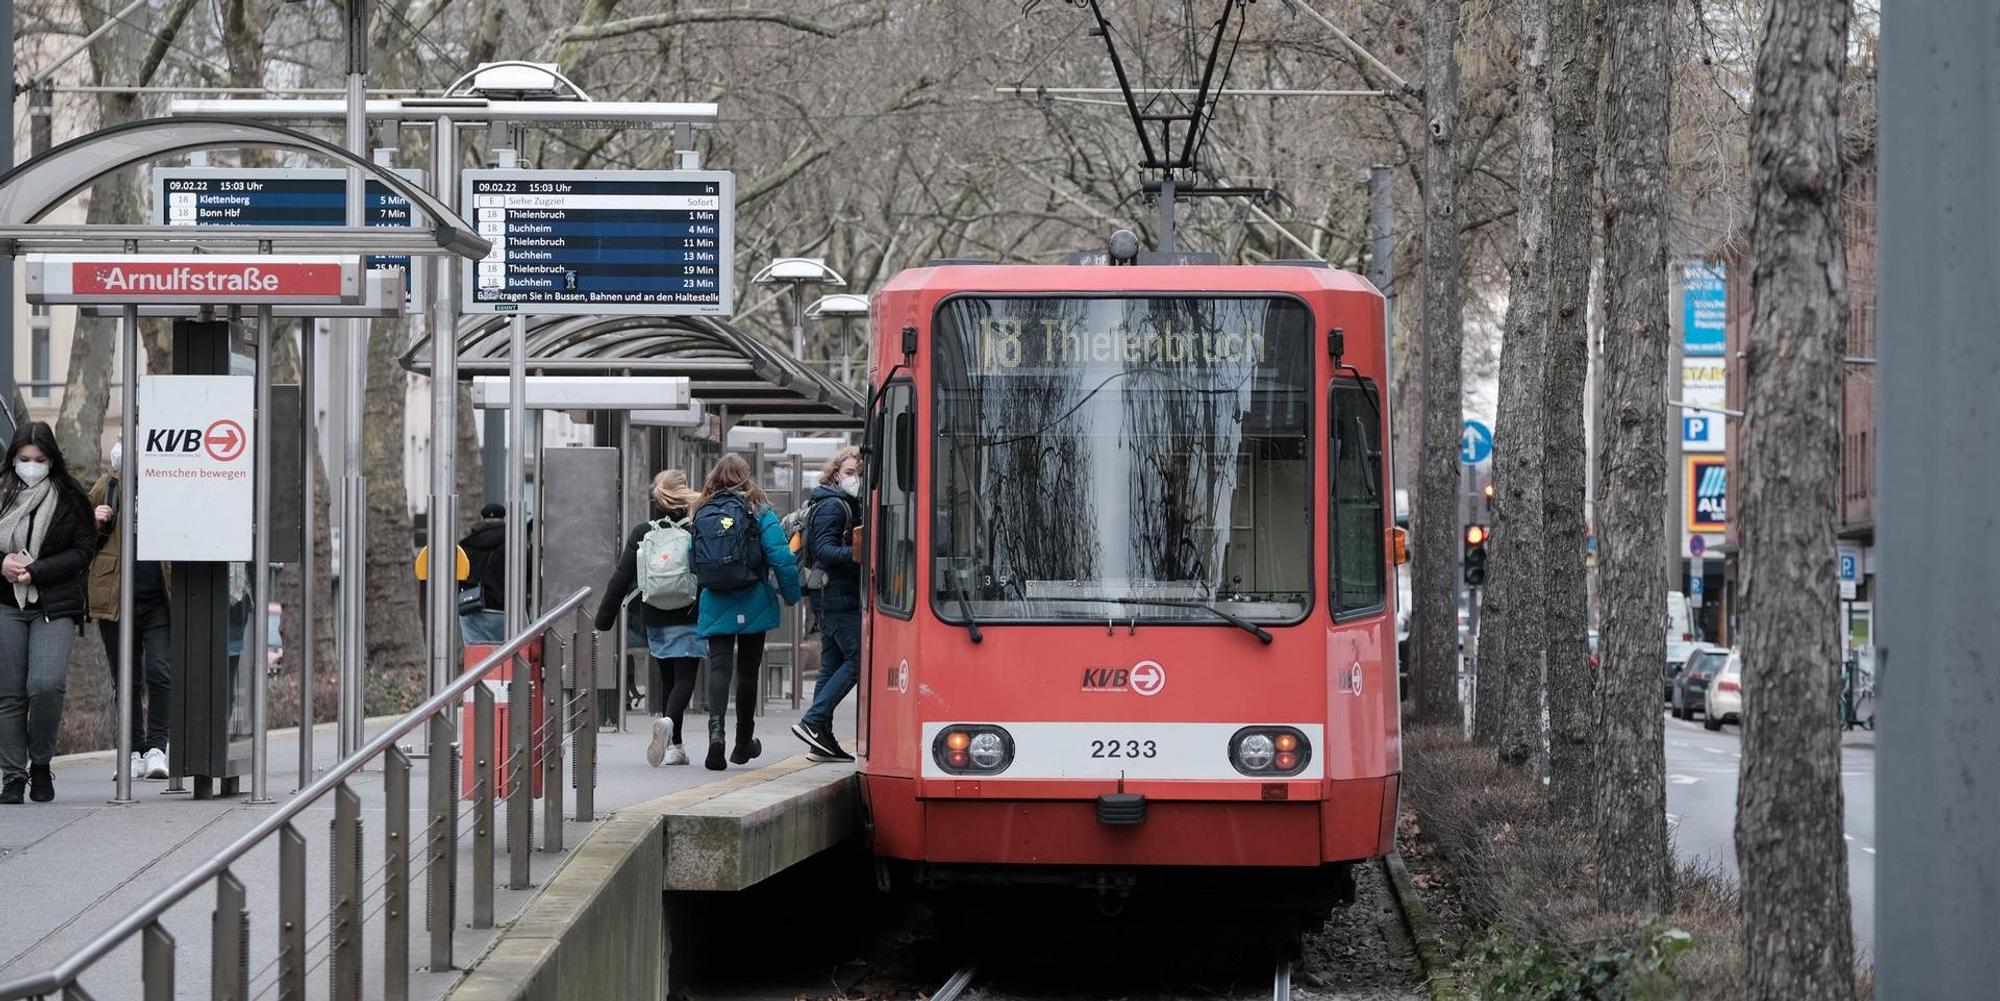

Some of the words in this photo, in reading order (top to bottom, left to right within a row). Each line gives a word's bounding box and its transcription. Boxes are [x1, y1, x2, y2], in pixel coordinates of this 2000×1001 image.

[169, 181, 208, 190] 09.02.22
[220, 181, 244, 191] 15:03
[246, 181, 264, 191] Uhr
[478, 183, 517, 192] 09.02.22
[529, 183, 553, 192] 15:03
[555, 183, 572, 192] Uhr
[705, 184, 714, 193] in
[200, 195, 250, 206] Klettenberg
[380, 196, 386, 205] 5
[388, 196, 406, 205] Min
[508, 197, 532, 206] Siehe
[534, 197, 565, 208] Zugziel
[687, 198, 714, 207] Sofort
[178, 209, 189, 217] 18
[200, 208, 223, 217] Bonn
[224, 208, 241, 217] Hbf
[380, 209, 386, 218] 7
[388, 209, 406, 218] Min
[487, 210, 497, 219] 18
[508, 210, 565, 219] Thielenbruch
[689, 211, 694, 220] 1
[696, 211, 714, 220] Min
[487, 224, 497, 233] 18
[508, 224, 552, 233] Buchheim
[688, 225, 695, 234] 4
[696, 225, 714, 234] Min
[508, 237, 565, 246] Thielenbruch
[683, 238, 695, 248] 11
[696, 239, 714, 248] Min
[508, 250, 552, 260] Buchheim
[683, 252, 695, 261] 13
[696, 252, 714, 261] Min
[487, 265, 497, 273] 18
[508, 264, 565, 274] Thielenbruch
[683, 266, 695, 275] 19
[696, 266, 714, 275] Min
[104, 266, 279, 291] Arnulfstraße
[508, 278, 552, 287] Buchheim
[683, 279, 695, 288] 23
[696, 279, 714, 288] Min
[529, 292, 543, 301] Sie
[544, 292, 553, 301] in
[555, 292, 588, 303] Bussen,
[590, 292, 622, 301] Bahnen
[624, 292, 642, 301] und
[643, 293, 655, 301] an
[656, 292, 673, 301] den
[979, 318, 1022, 368] 18
[1041, 319, 1264, 363] Thielenbruch
[145, 428, 202, 453] KVB
[144, 467, 197, 478] Menschen
[200, 467, 246, 480] bewegen
[1082, 668, 1129, 688] KVB
[1091, 739, 1157, 759] 2233
